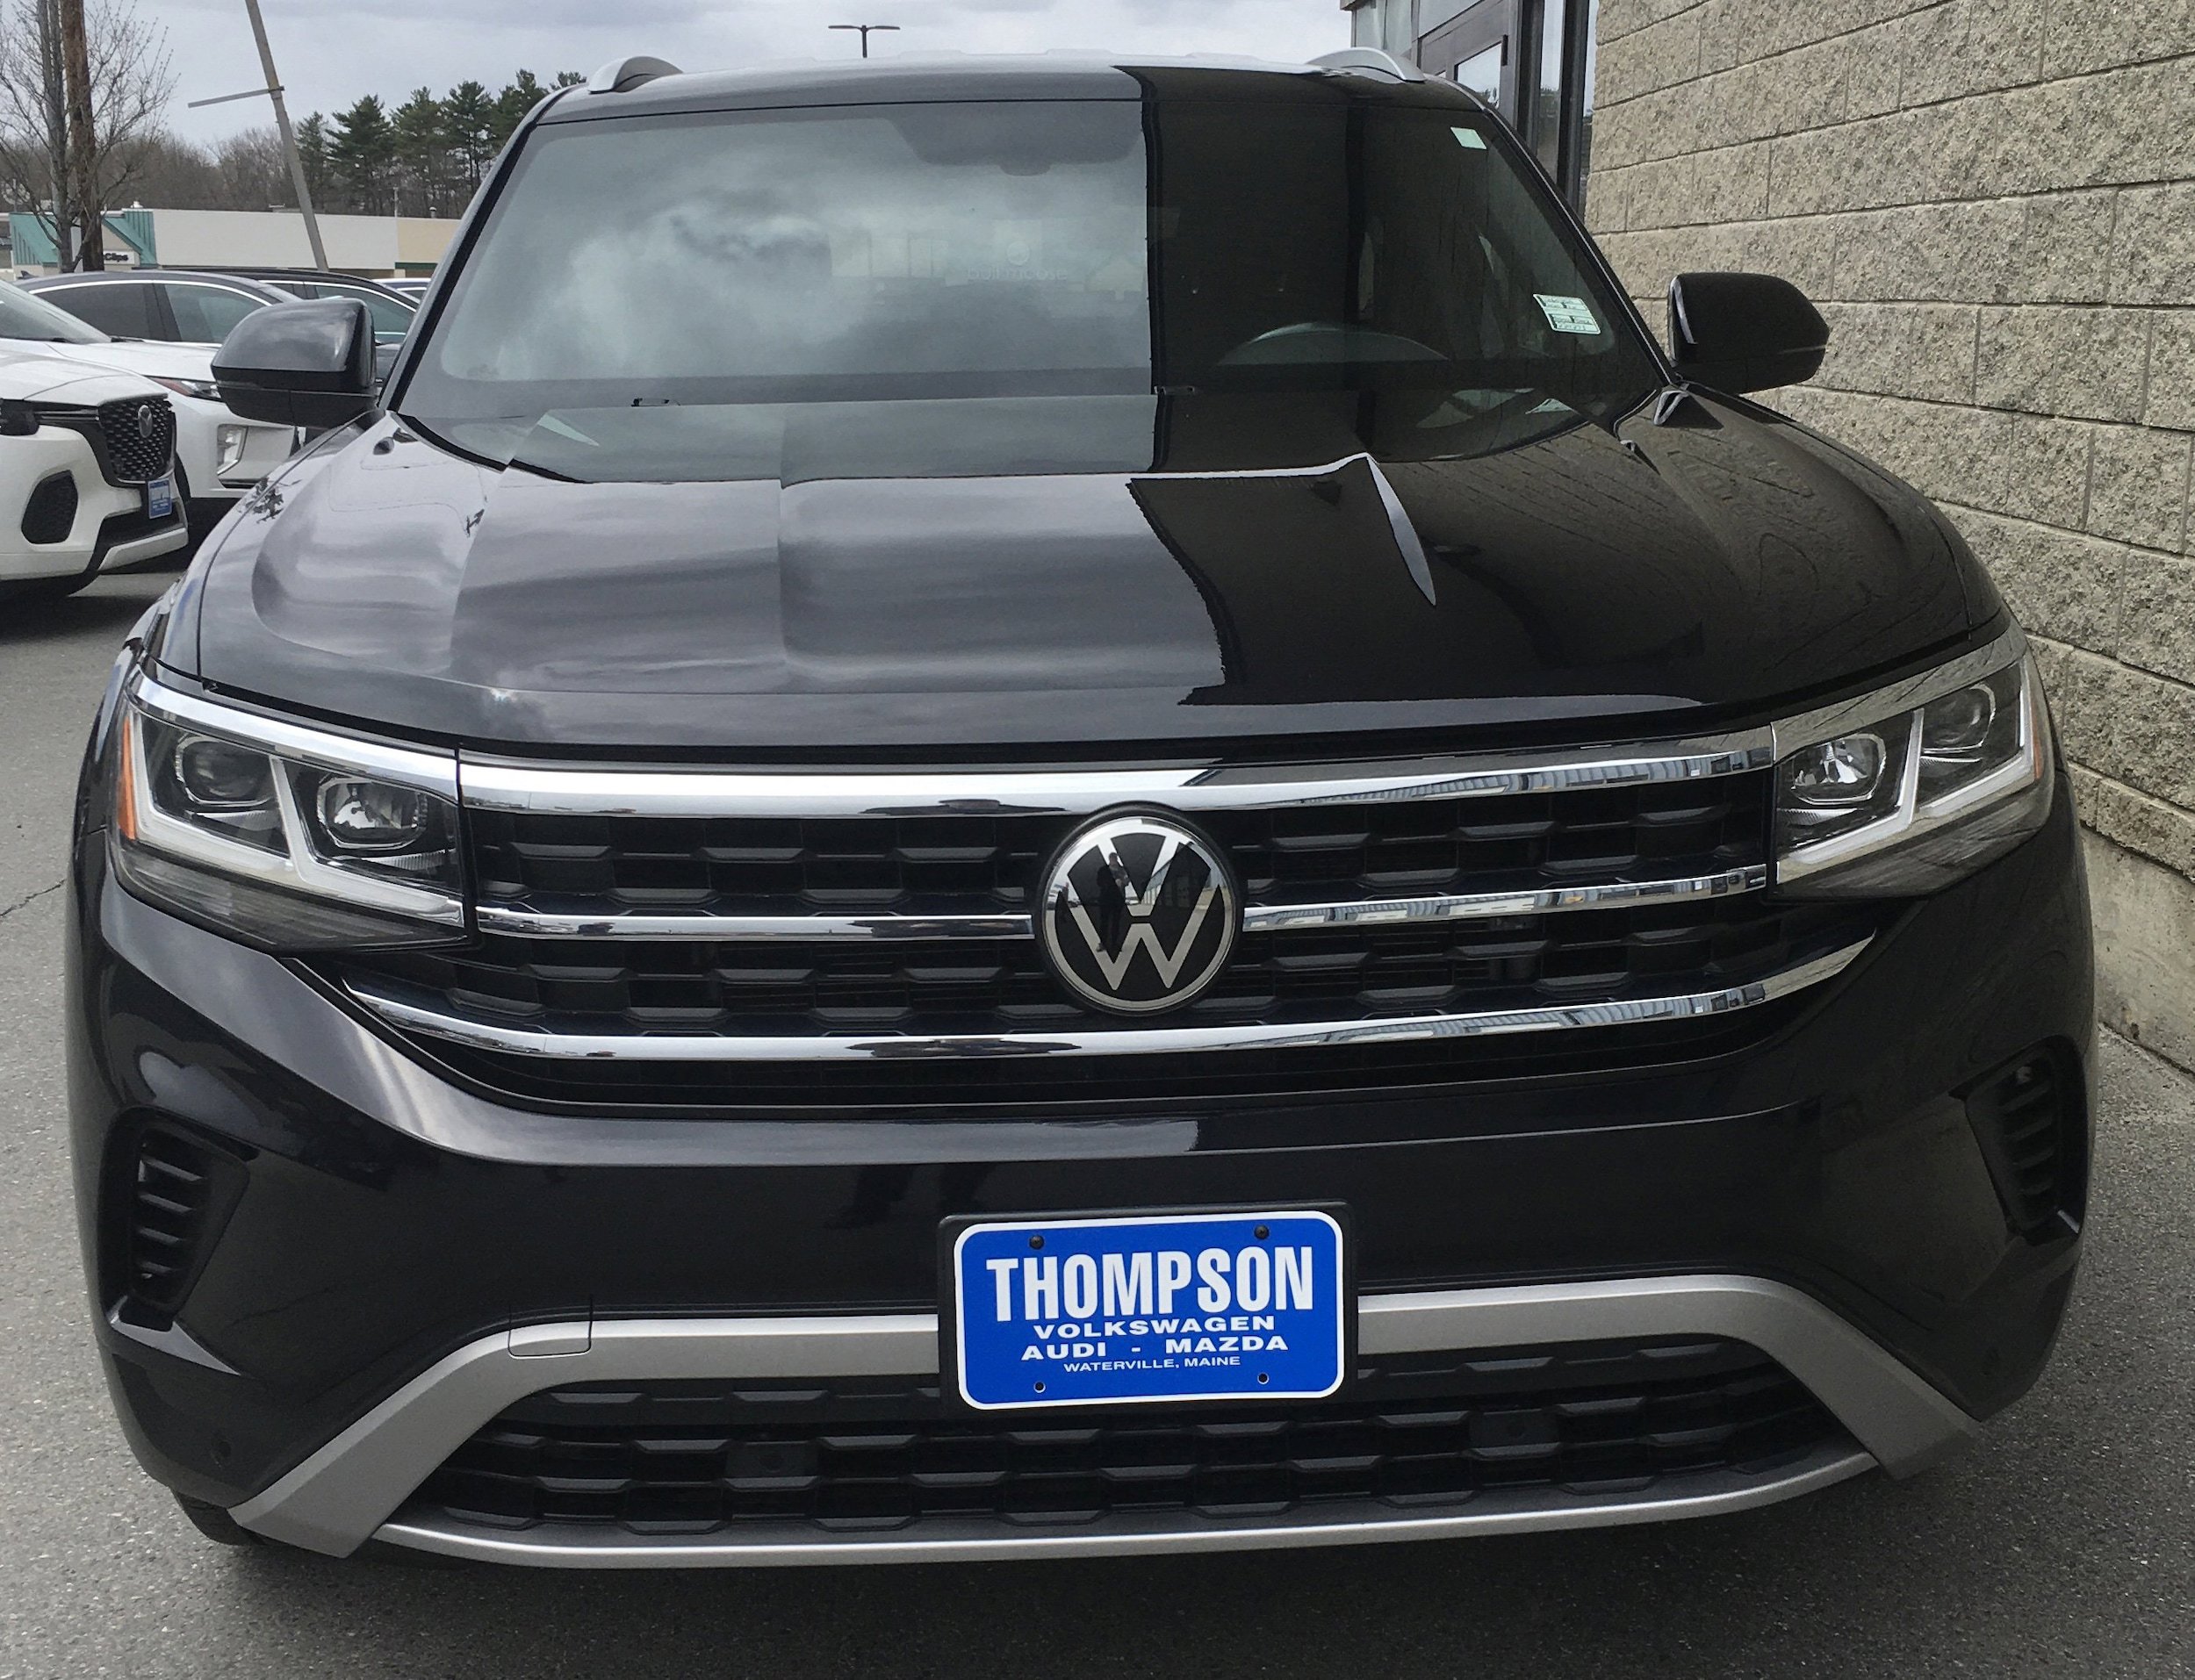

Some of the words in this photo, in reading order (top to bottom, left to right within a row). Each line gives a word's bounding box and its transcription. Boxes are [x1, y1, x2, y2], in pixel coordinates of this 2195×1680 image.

[986, 1246, 1313, 1322] THOMPSON
[1033, 1316, 1275, 1339] VOLKSWAGEN
[1021, 1342, 1106, 1361] AUDI
[1164, 1335, 1288, 1354] MAZDA
[1063, 1359, 1180, 1372] WATERVILLE,
[1184, 1356, 1241, 1368] MAINE
